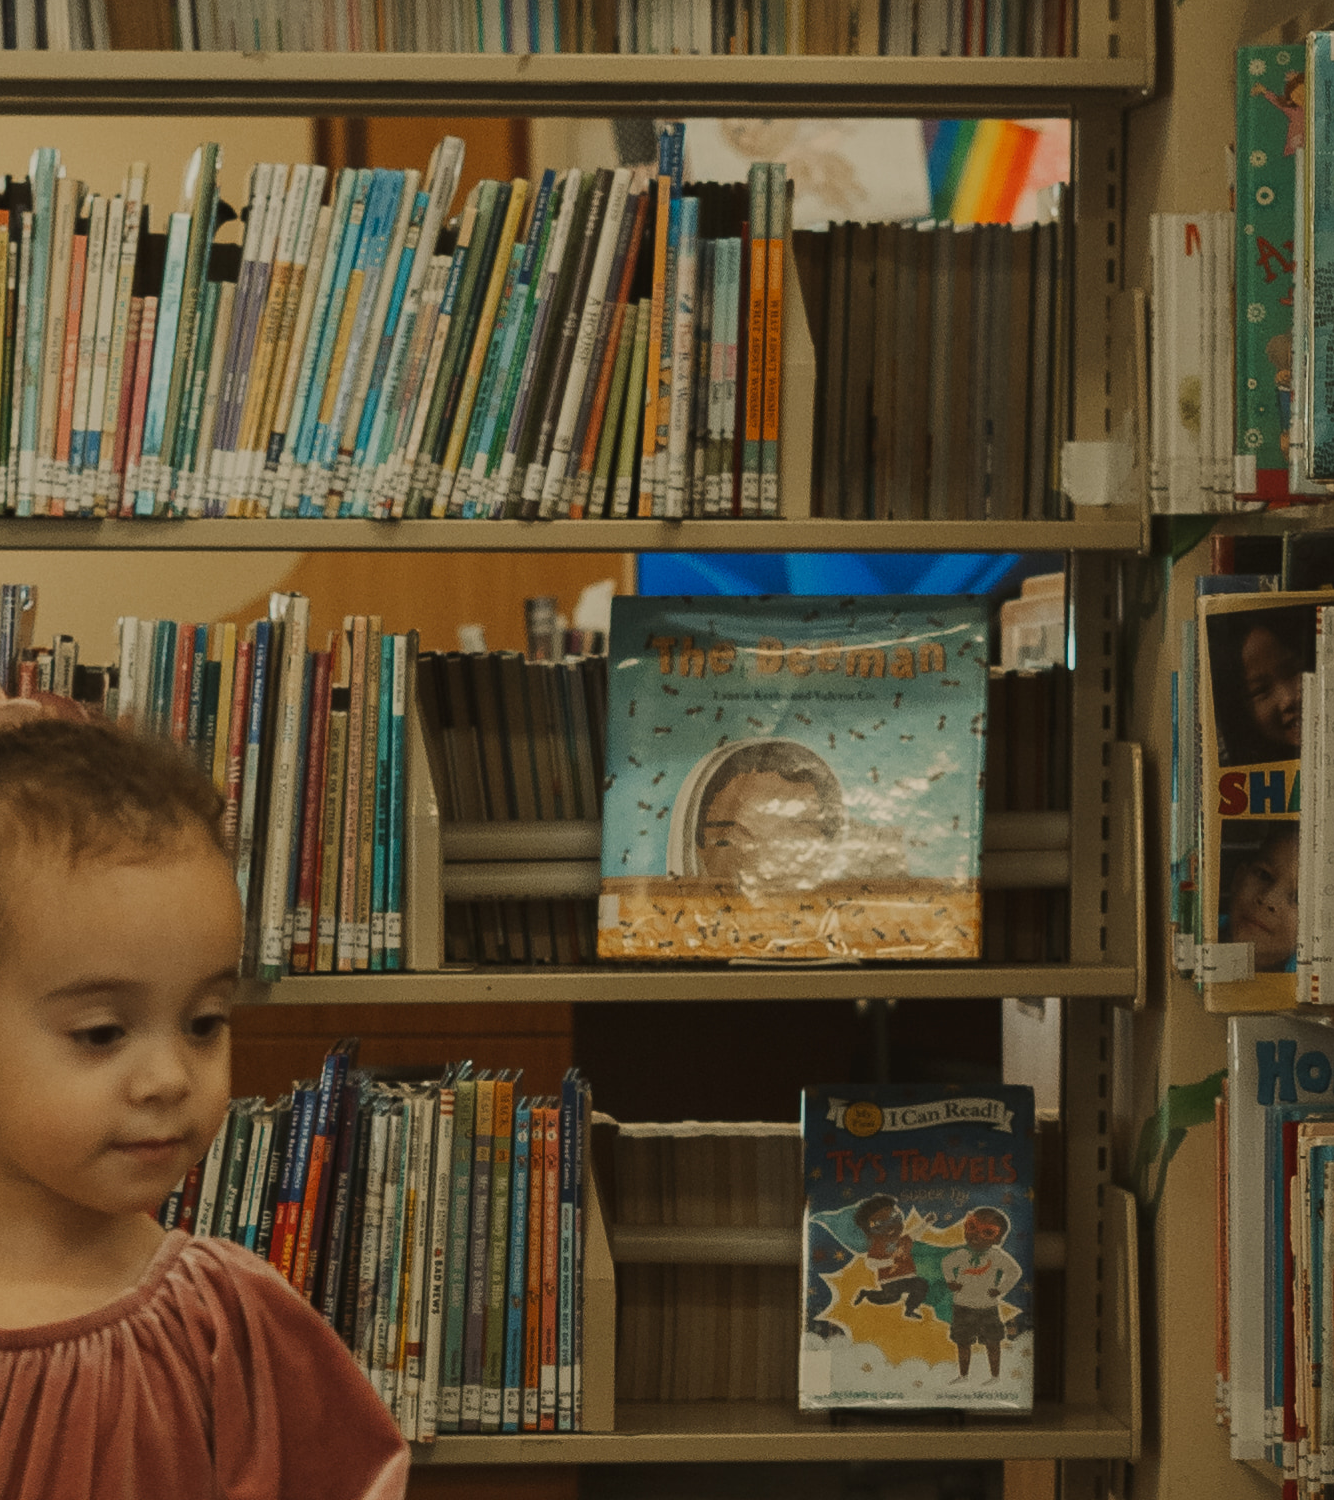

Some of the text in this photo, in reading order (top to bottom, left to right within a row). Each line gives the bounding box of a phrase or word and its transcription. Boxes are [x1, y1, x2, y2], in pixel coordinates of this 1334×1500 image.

[578, 297, 600, 363] A HOUSE
[752, 300, 762, 332] WHAT
[768, 300, 779, 332] WHAT
[750, 336, 761, 374] ABOUT
[767, 336, 779, 375] ABOUT
[675, 387, 688, 430] Woman
[652, 636, 946, 678] The Beeman
[901, 1107, 940, 1126] Can
[944, 1101, 1000, 1121] Read!
[475, 1175, 488, 1193] Mr.
[497, 1176, 508, 1193] Mr.
[892, 1150, 1018, 1184] TRAVELS
[225, 1184, 238, 1229] Frog and
[472, 1198, 486, 1236] Monkey
[492, 1198, 505, 1236] Monkey
[473, 1239, 486, 1267] Visits
[431, 1260, 444, 1314] BAD NEWS
[471, 1280, 484, 1314] School
[491, 1284, 503, 1309] Hike
